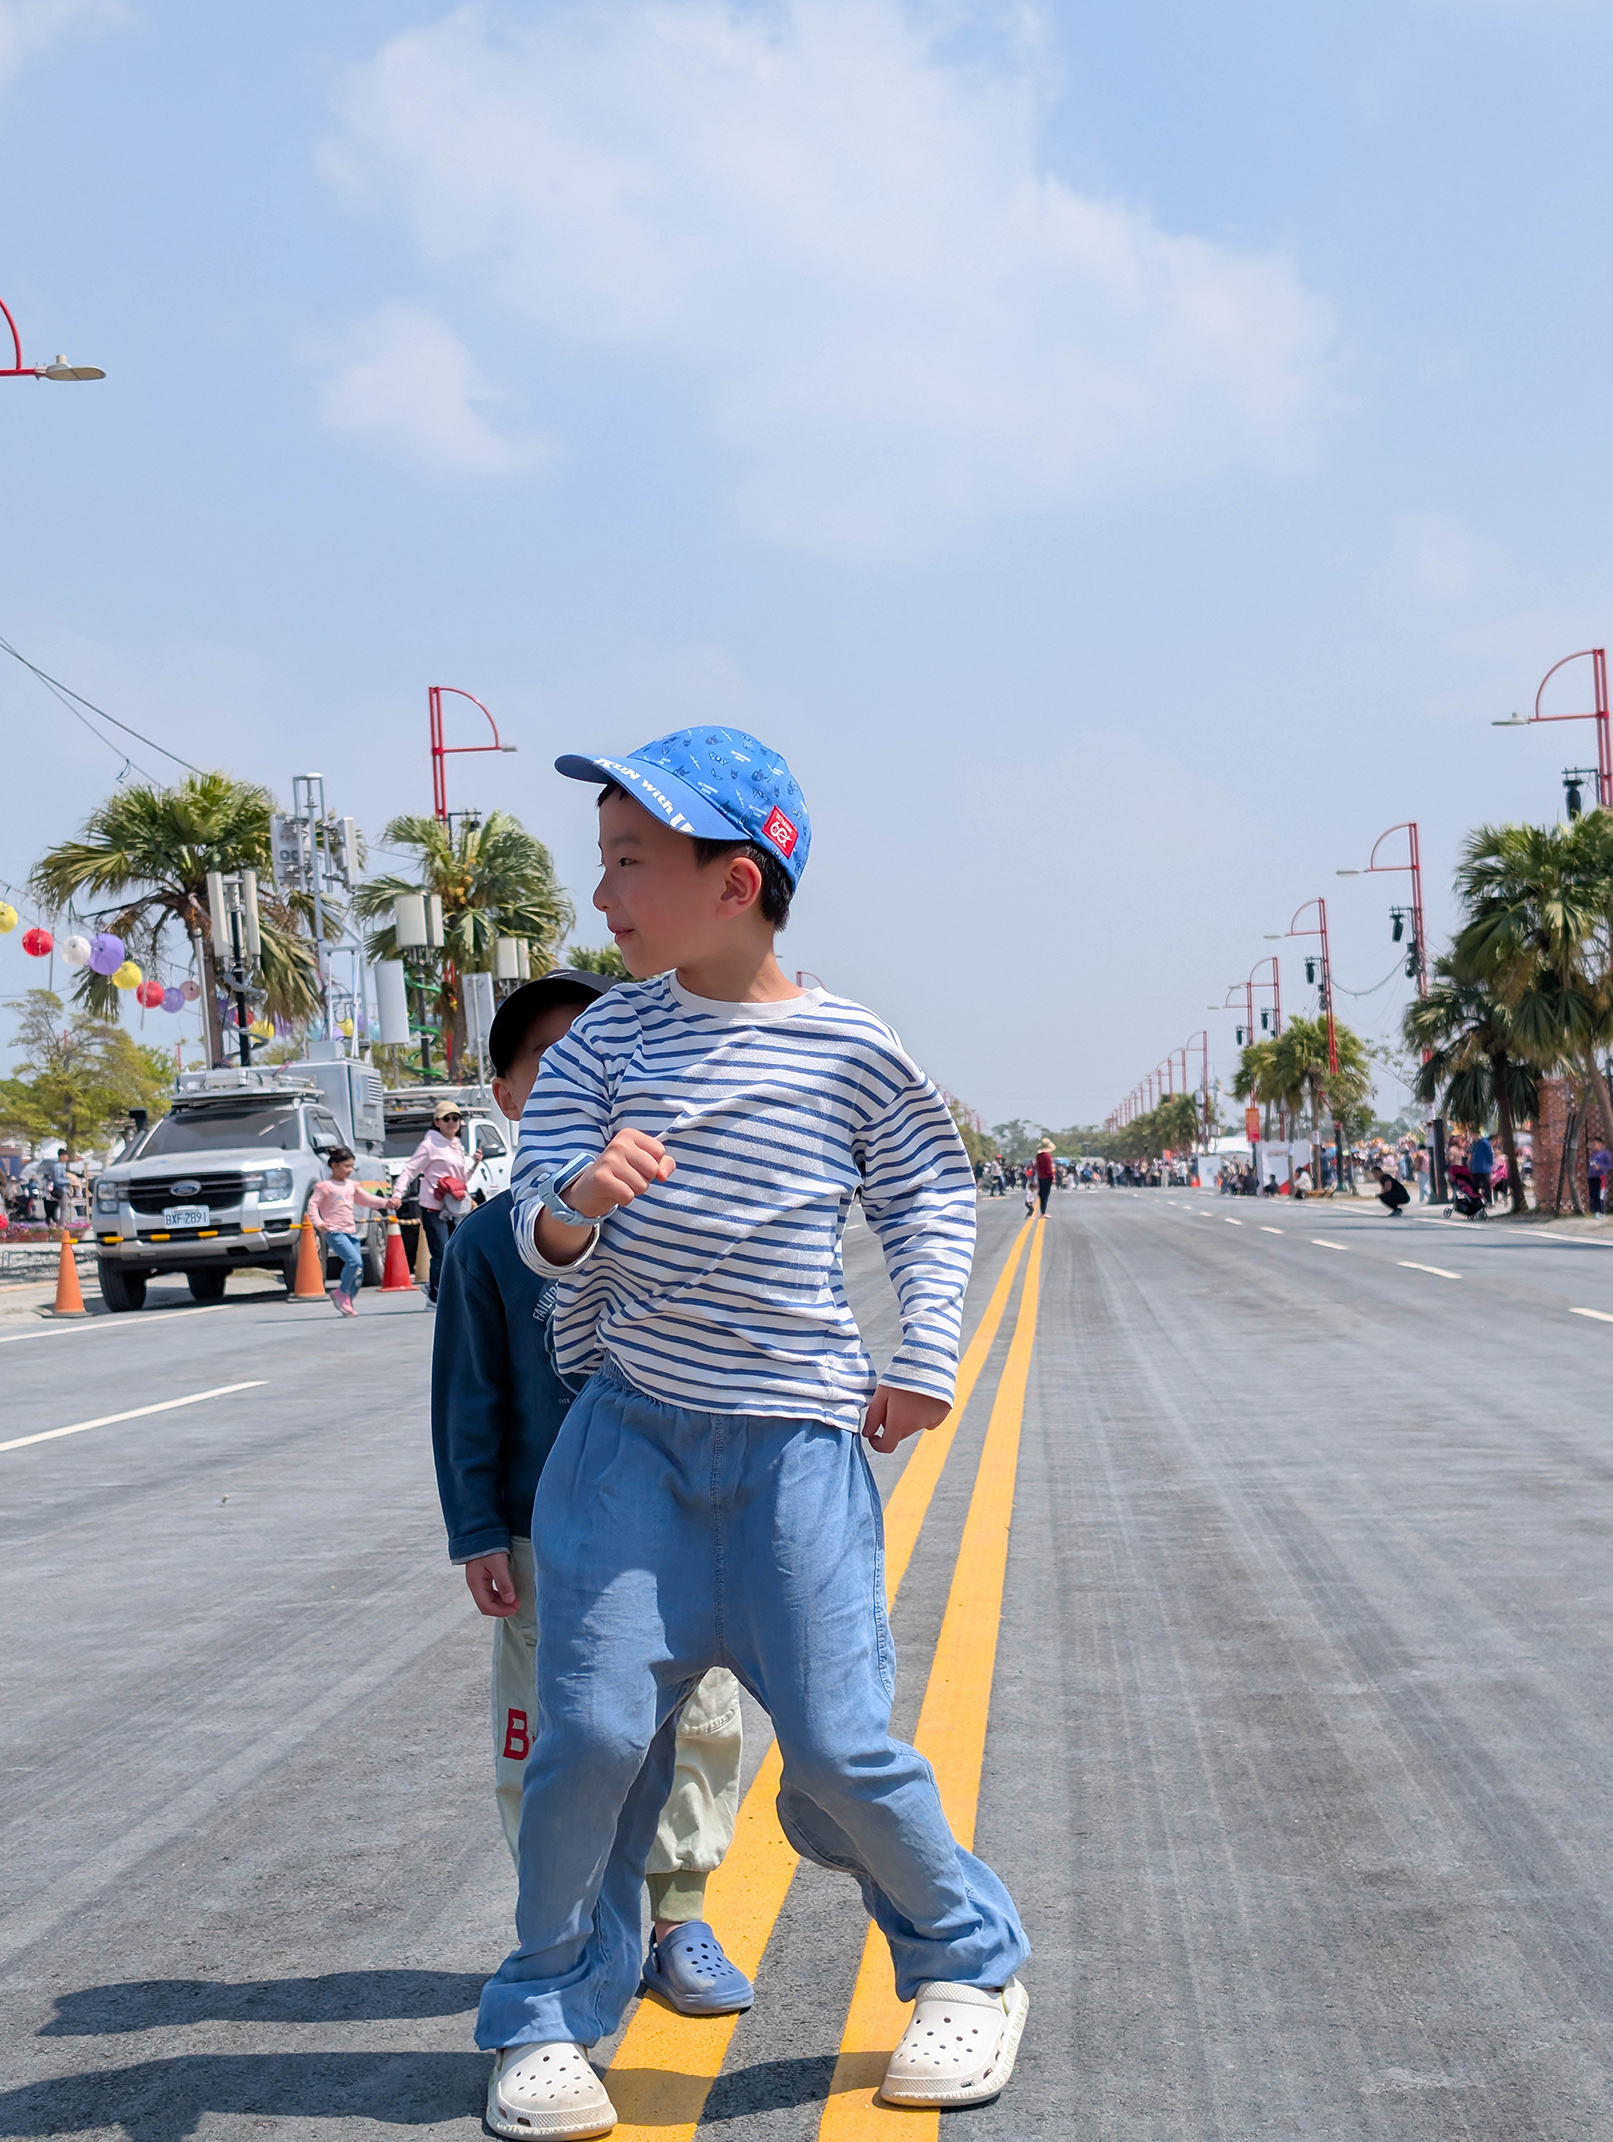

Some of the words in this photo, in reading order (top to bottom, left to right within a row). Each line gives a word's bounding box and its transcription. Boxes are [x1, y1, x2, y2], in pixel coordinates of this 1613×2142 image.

[594, 758, 641, 780] RUN
[641, 779, 674, 815] with
[532, 1281, 558, 1322] FAILUR
[503, 1708, 535, 1760] B
[986, 2075, 1003, 2091] LIFE
[1001, 2068, 1008, 2079] IS
